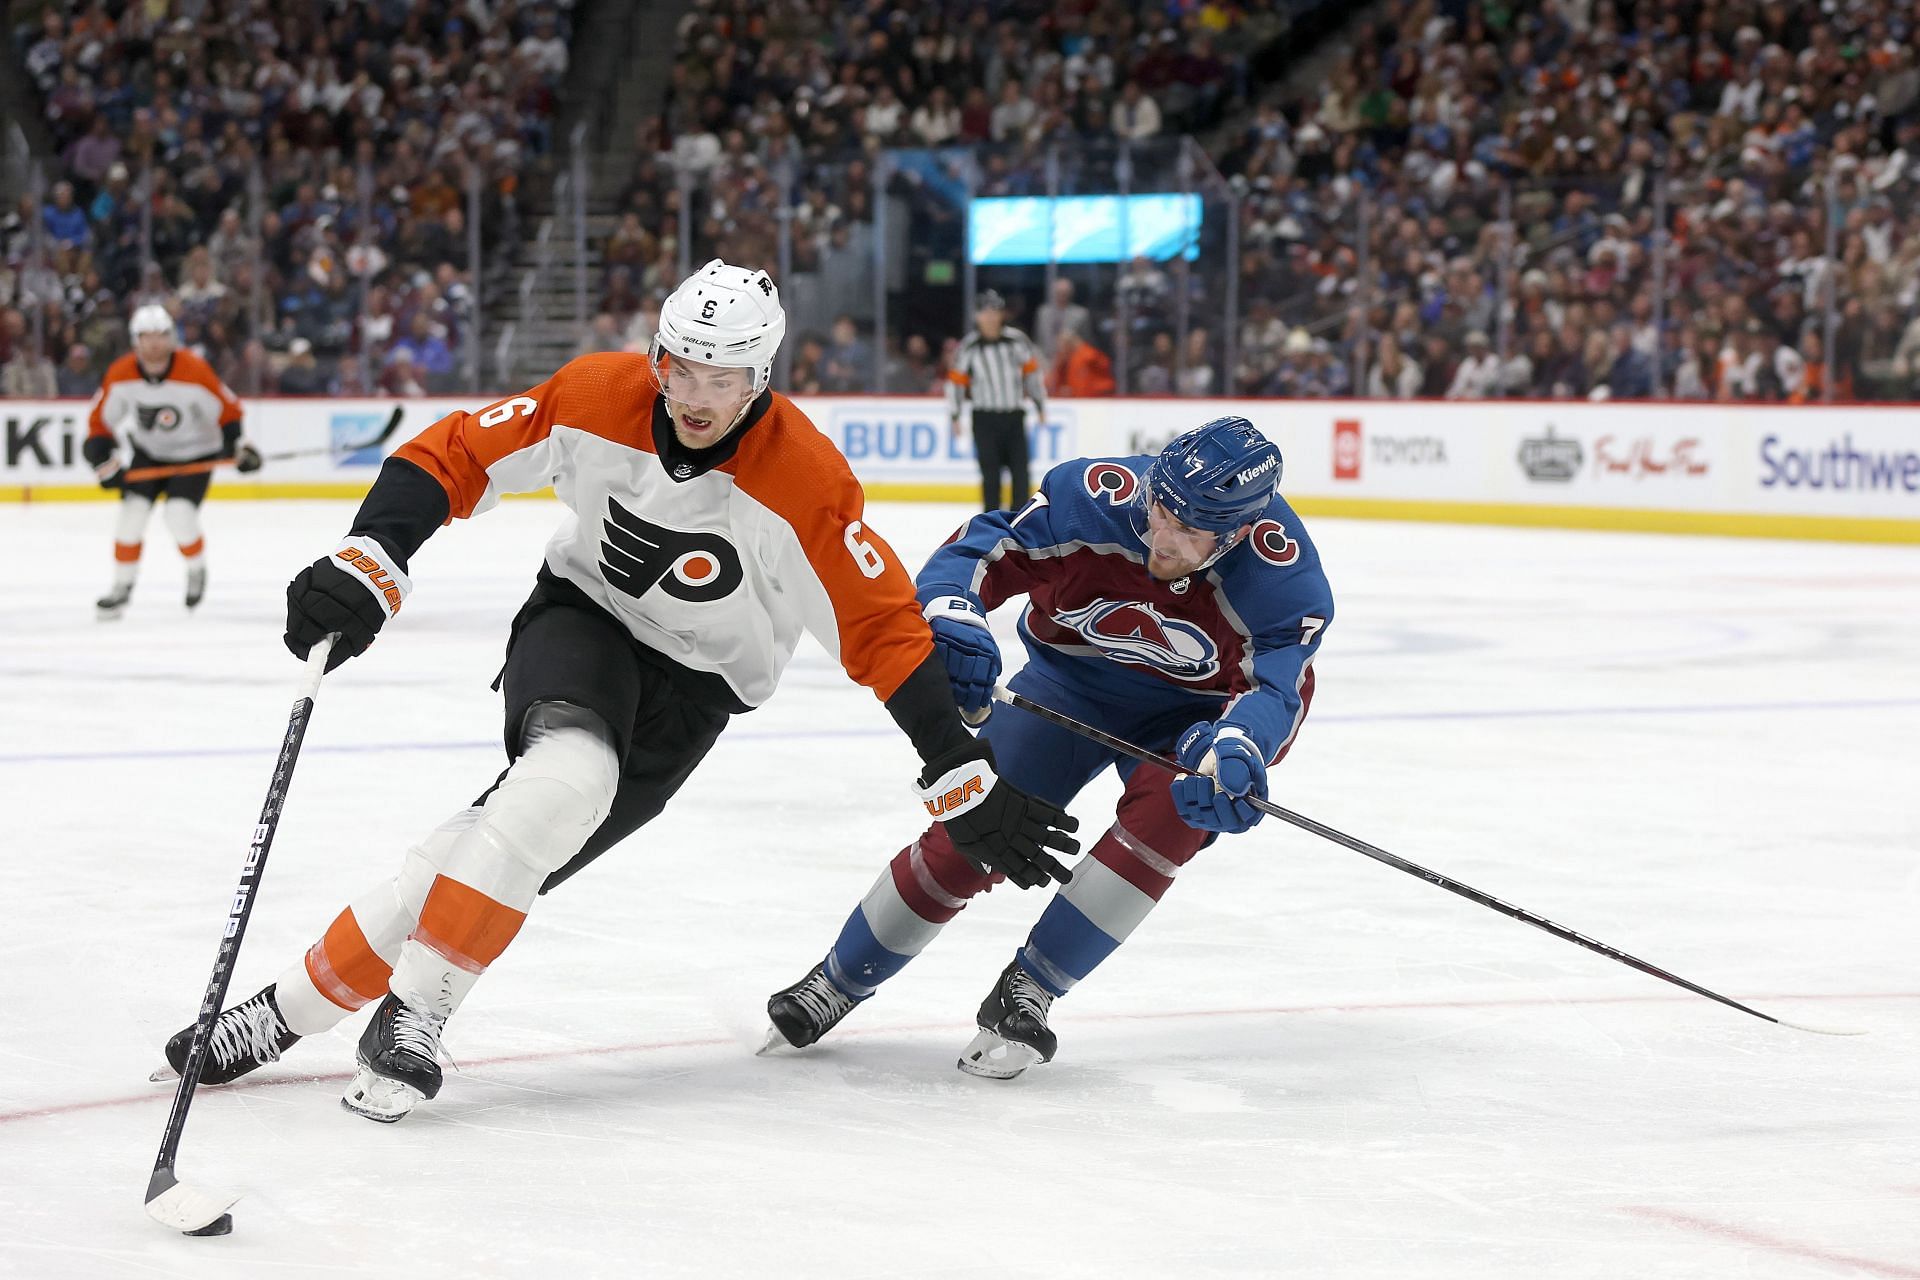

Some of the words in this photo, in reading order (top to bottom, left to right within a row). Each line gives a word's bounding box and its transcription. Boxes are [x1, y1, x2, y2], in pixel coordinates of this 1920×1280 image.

[702, 300, 718, 319] 6
[479, 396, 538, 429] 6
[843, 423, 938, 459] BUD
[1371, 435, 1447, 465] TOYOTA
[1236, 453, 1279, 486] Kiewit
[1759, 431, 1920, 493] Southwe
[1159, 481, 1188, 507] BAUER
[844, 520, 886, 579] 6
[1300, 616, 1325, 646] 7
[1181, 729, 1201, 755] MACH
